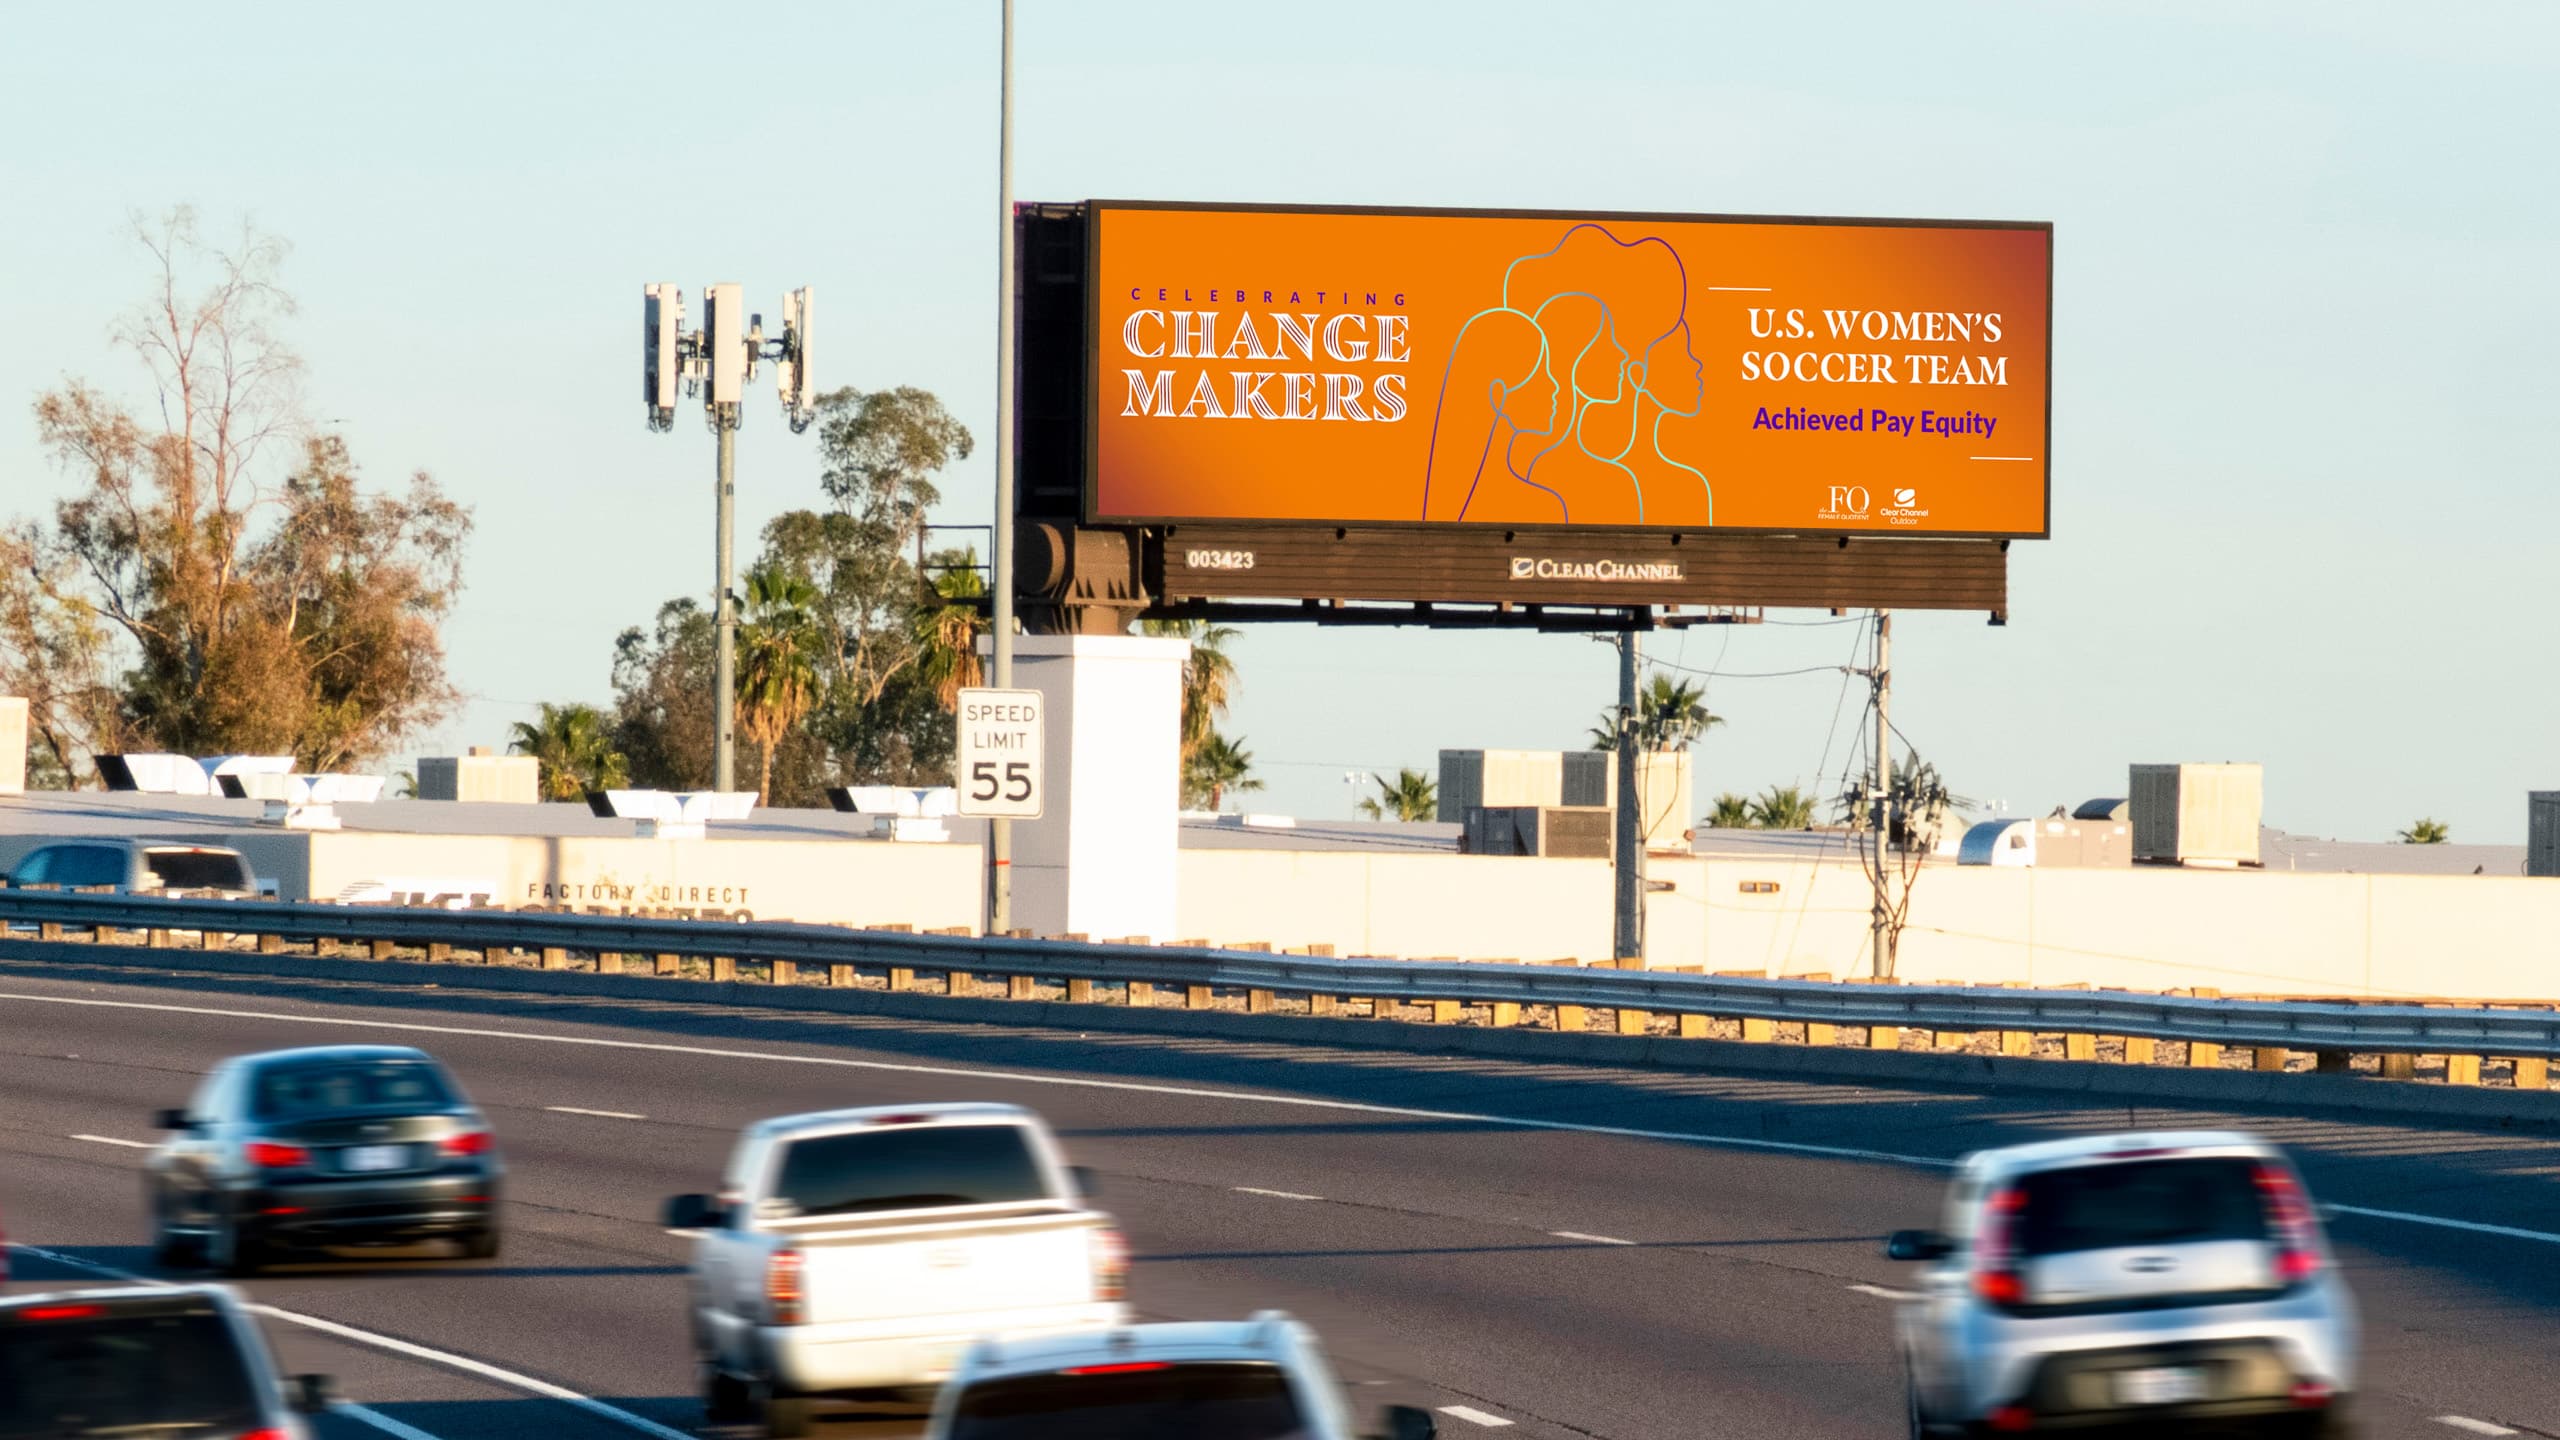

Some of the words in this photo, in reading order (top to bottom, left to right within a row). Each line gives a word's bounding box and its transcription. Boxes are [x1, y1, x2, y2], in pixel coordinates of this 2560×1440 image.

[1131, 287, 1406, 306] CELEBRATING
[1122, 309, 1411, 363] CHANGE
[1747, 308, 1815, 339] U.S.
[1822, 310, 2003, 343] WOMEN’S
[1741, 351, 1898, 384] SOCCER
[1904, 355, 2009, 386] TEAM
[1120, 368, 1408, 423] MAKERS
[1752, 407, 1863, 432] Achieved
[1872, 409, 1915, 437] Pay
[1921, 411, 1997, 439] Equity
[1827, 485, 1870, 514] FQ
[1880, 508, 1899, 516] Clear
[1900, 508, 1929, 517] Channel
[1890, 516, 1918, 525] Outdoor
[1188, 550, 1255, 569] 003423
[967, 704, 1036, 722] SPEED
[974, 732, 1027, 749] LIMIT
[971, 762, 1032, 802] 55
[528, 883, 635, 901] FACTORY
[662, 886, 749, 904] DIRECT
